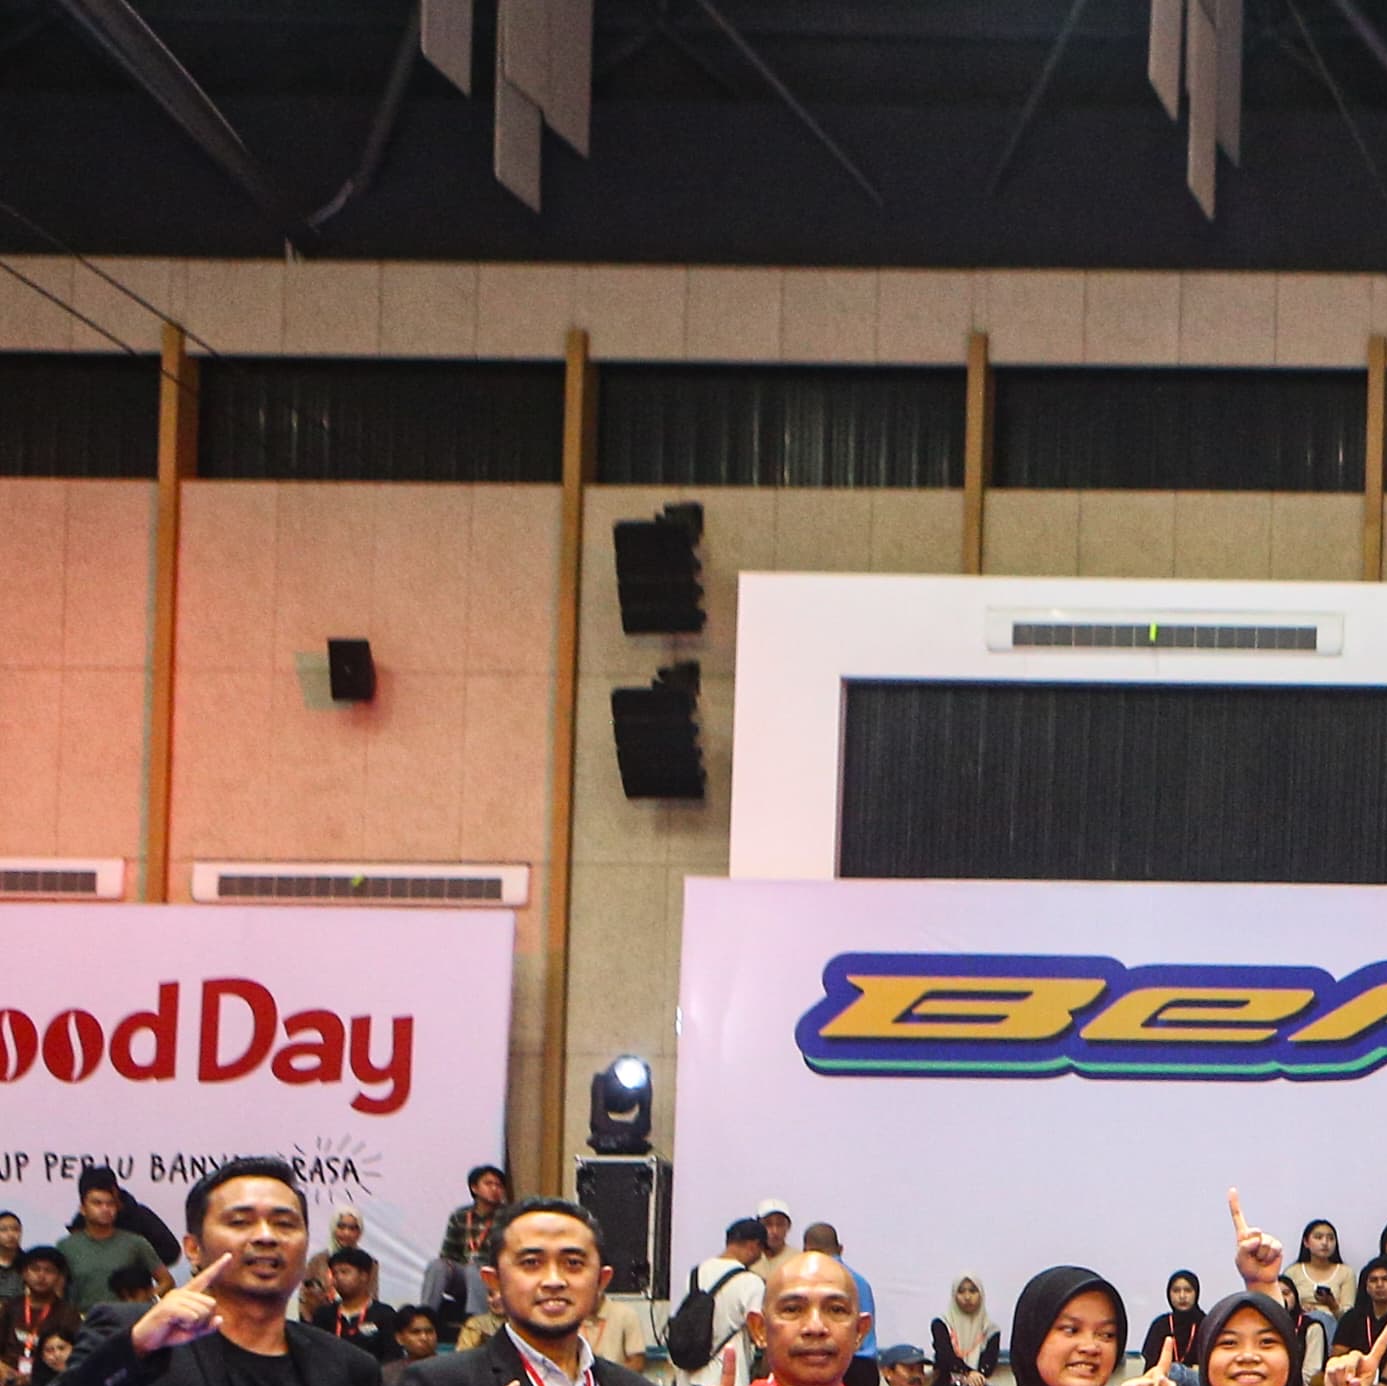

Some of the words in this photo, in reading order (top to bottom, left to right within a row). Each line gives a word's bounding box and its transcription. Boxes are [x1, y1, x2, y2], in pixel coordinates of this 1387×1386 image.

[197, 976, 415, 1116] Day
[43, 1150, 134, 1183] PERU
[292, 1155, 361, 1185] RASA
